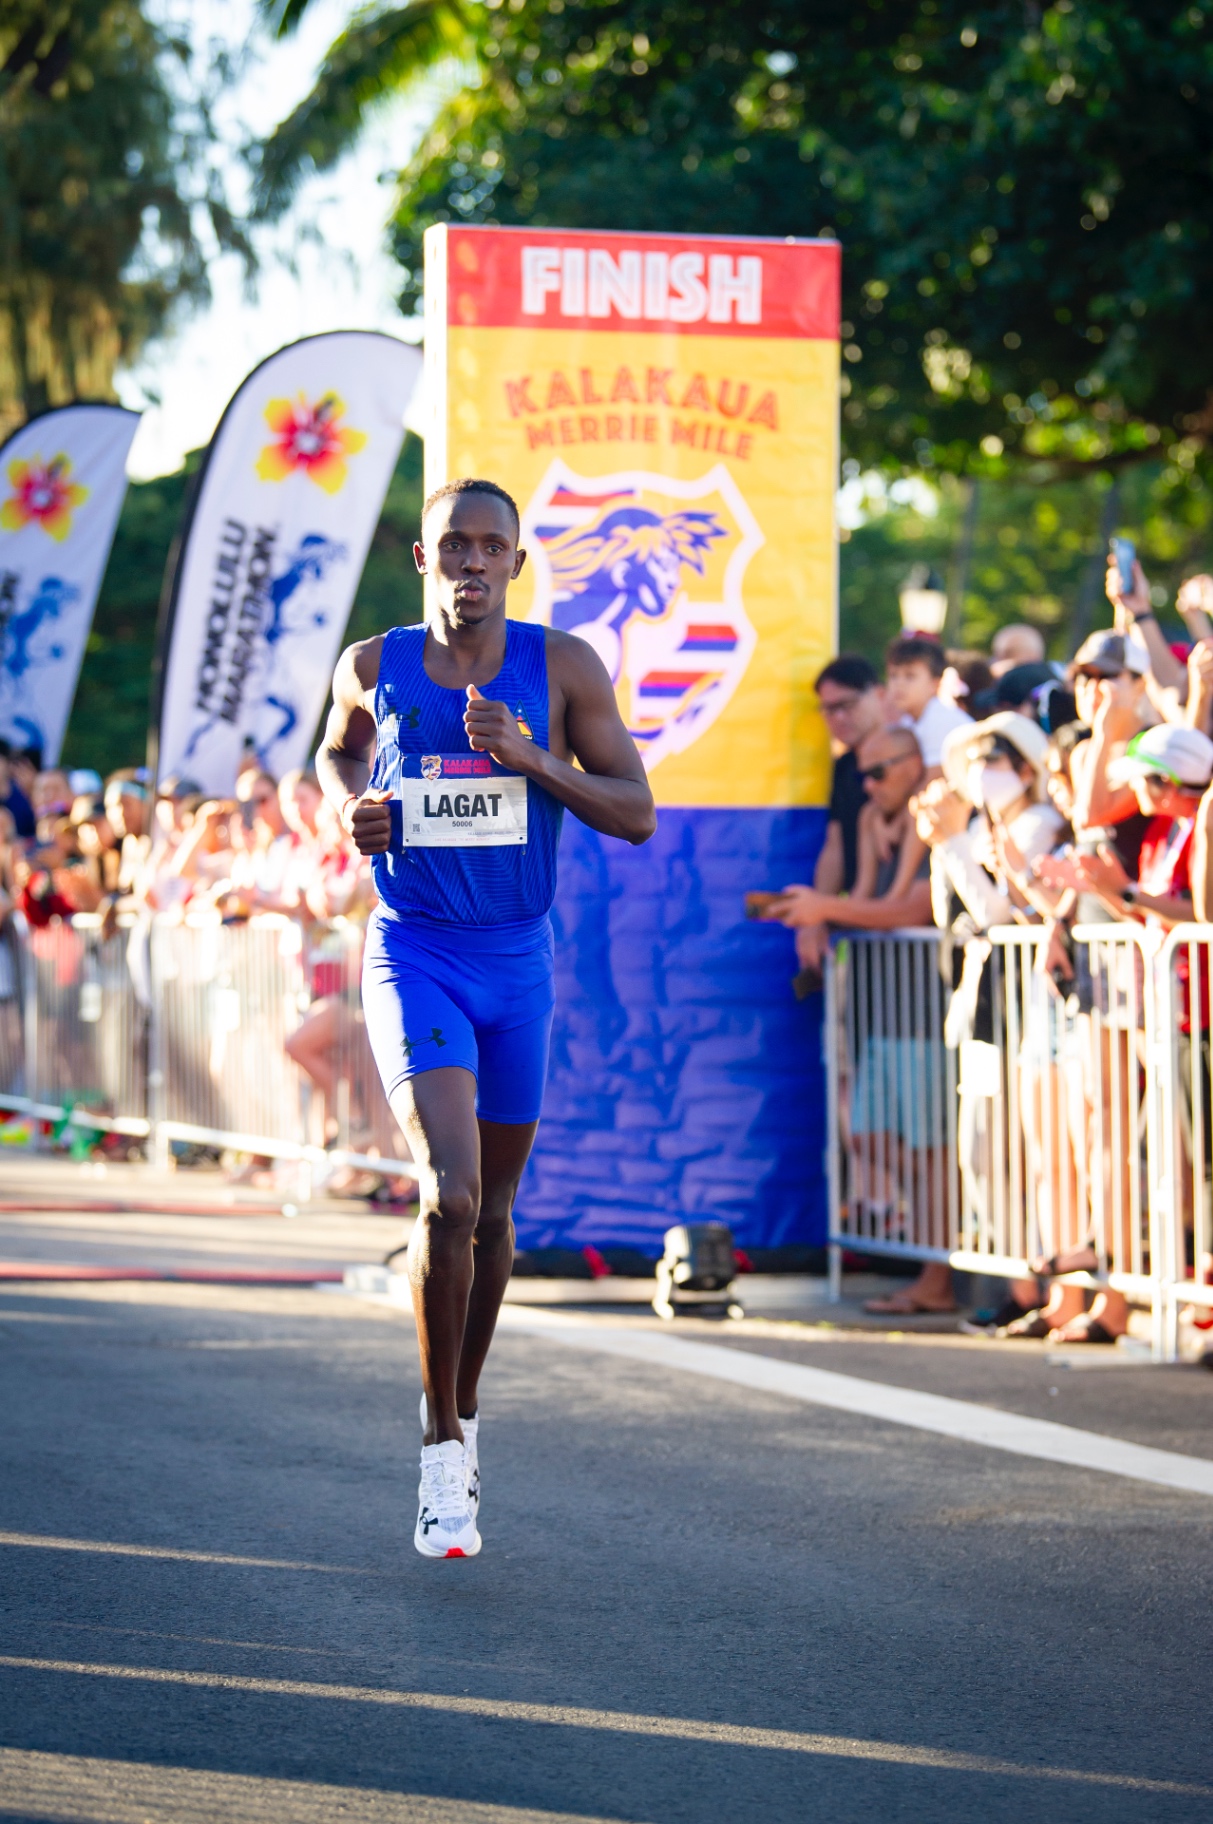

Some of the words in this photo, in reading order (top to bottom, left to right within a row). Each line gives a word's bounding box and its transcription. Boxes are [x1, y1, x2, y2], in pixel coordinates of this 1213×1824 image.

[520, 246, 763, 325] FINISH
[504, 365, 780, 432] KALAKAUA
[526, 413, 658, 452] MERRIE
[671, 419, 754, 461] MILE
[197, 518, 247, 713] HONOLULU
[220, 526, 276, 725] MARATHON
[424, 793, 502, 818] LAGAT
